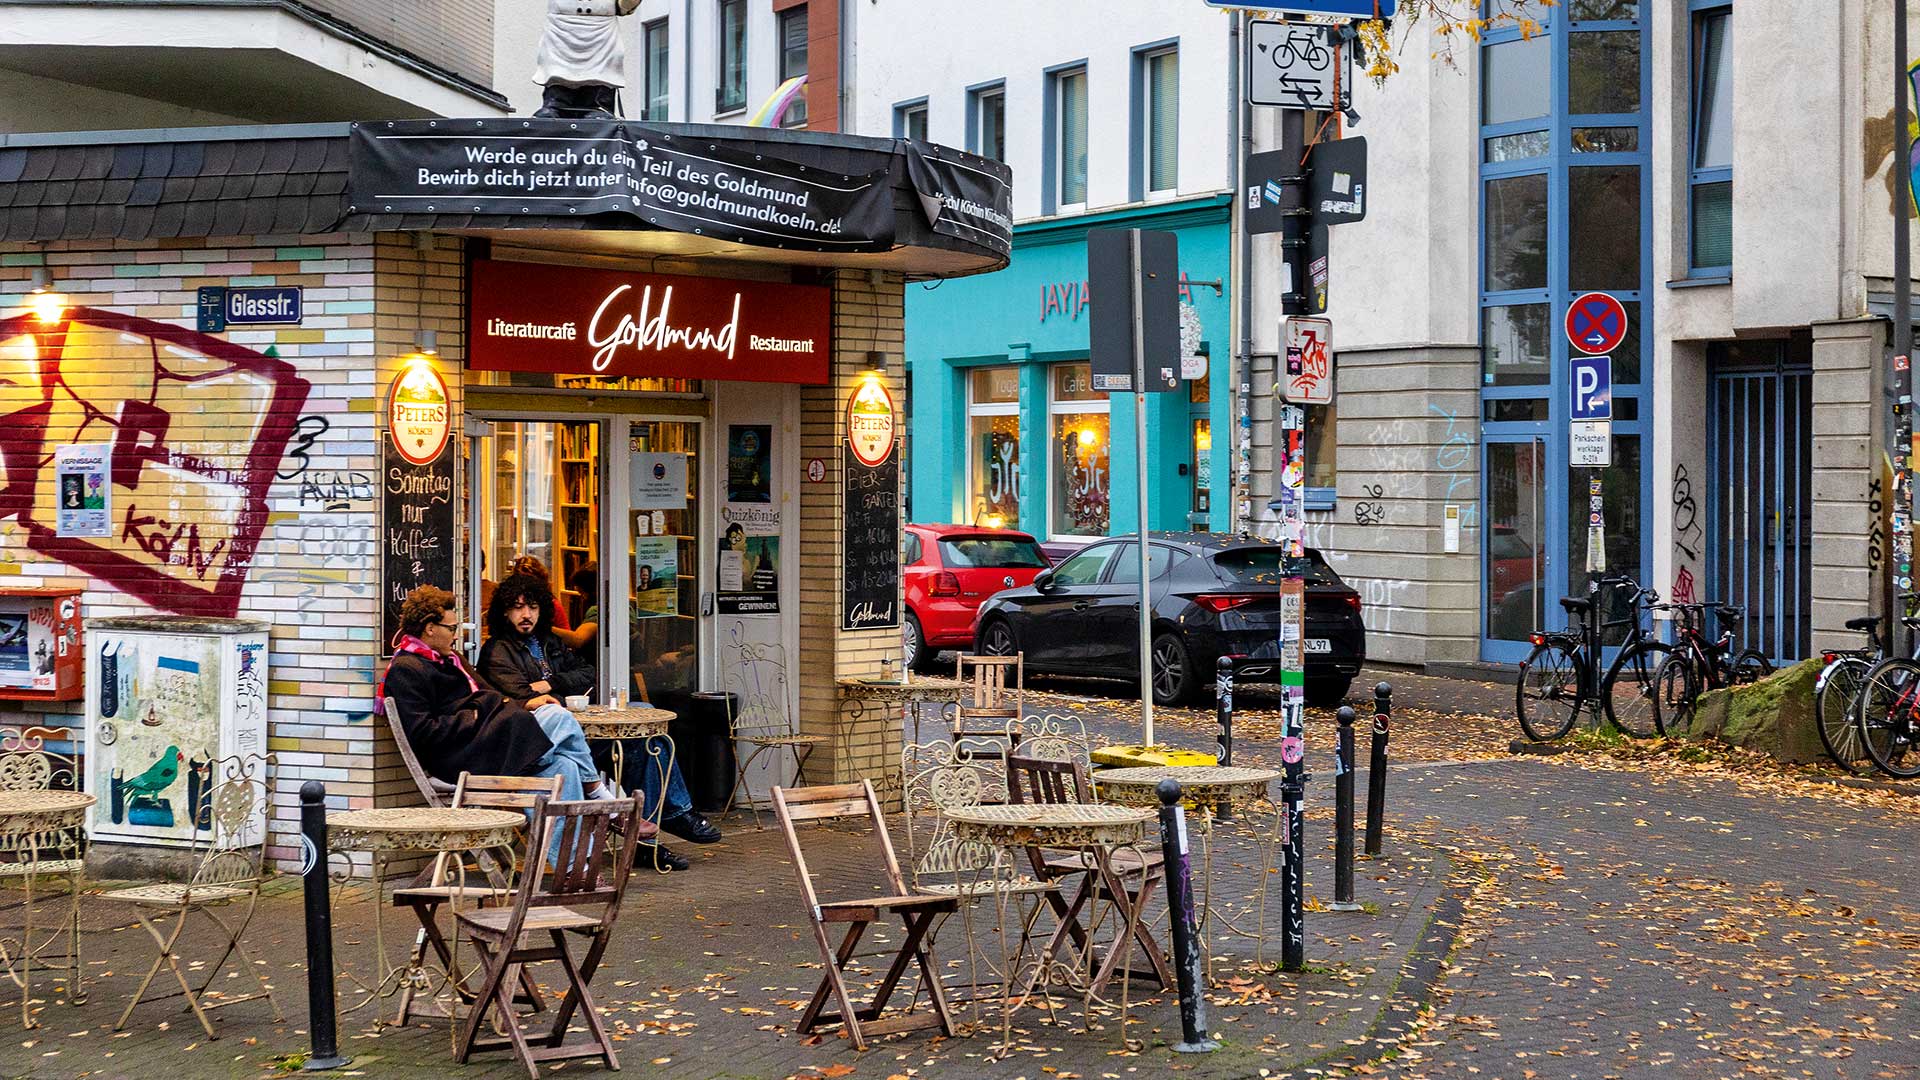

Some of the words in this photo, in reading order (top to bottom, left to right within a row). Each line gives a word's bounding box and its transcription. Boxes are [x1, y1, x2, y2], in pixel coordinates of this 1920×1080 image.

[464, 147, 527, 164] Werde
[532, 148, 576, 166] auch
[584, 149, 607, 165] du
[612, 150, 636, 169] ein
[643, 155, 672, 178] Teil
[677, 165, 709, 185] des
[714, 172, 809, 207] Goldmund
[418, 168, 479, 186] Bewirb
[484, 169, 524, 186] dich
[527, 170, 570, 191] jetzt
[576, 172, 624, 187] unter
[627, 173, 841, 233] info@goldmundkoeln.de!
[231, 293, 294, 316] Glasstr.
[487, 319, 577, 341] Literaturcafé
[587, 284, 741, 372] Goldmund
[749, 334, 815, 354] Restaurant
[1063, 374, 1086, 393] Café
[396, 405, 444, 422] PETERS
[853, 415, 891, 431] PETERS
[61, 457, 103, 465] VERNISSAGE
[388, 466, 451, 504] Sonntag
[402, 504, 430, 523] nur
[722, 508, 780, 525] Quizkönig
[391, 528, 439, 559] Kaffee
[850, 602, 892, 629] Goldmund
[1316, 640, 1327, 650] 97
